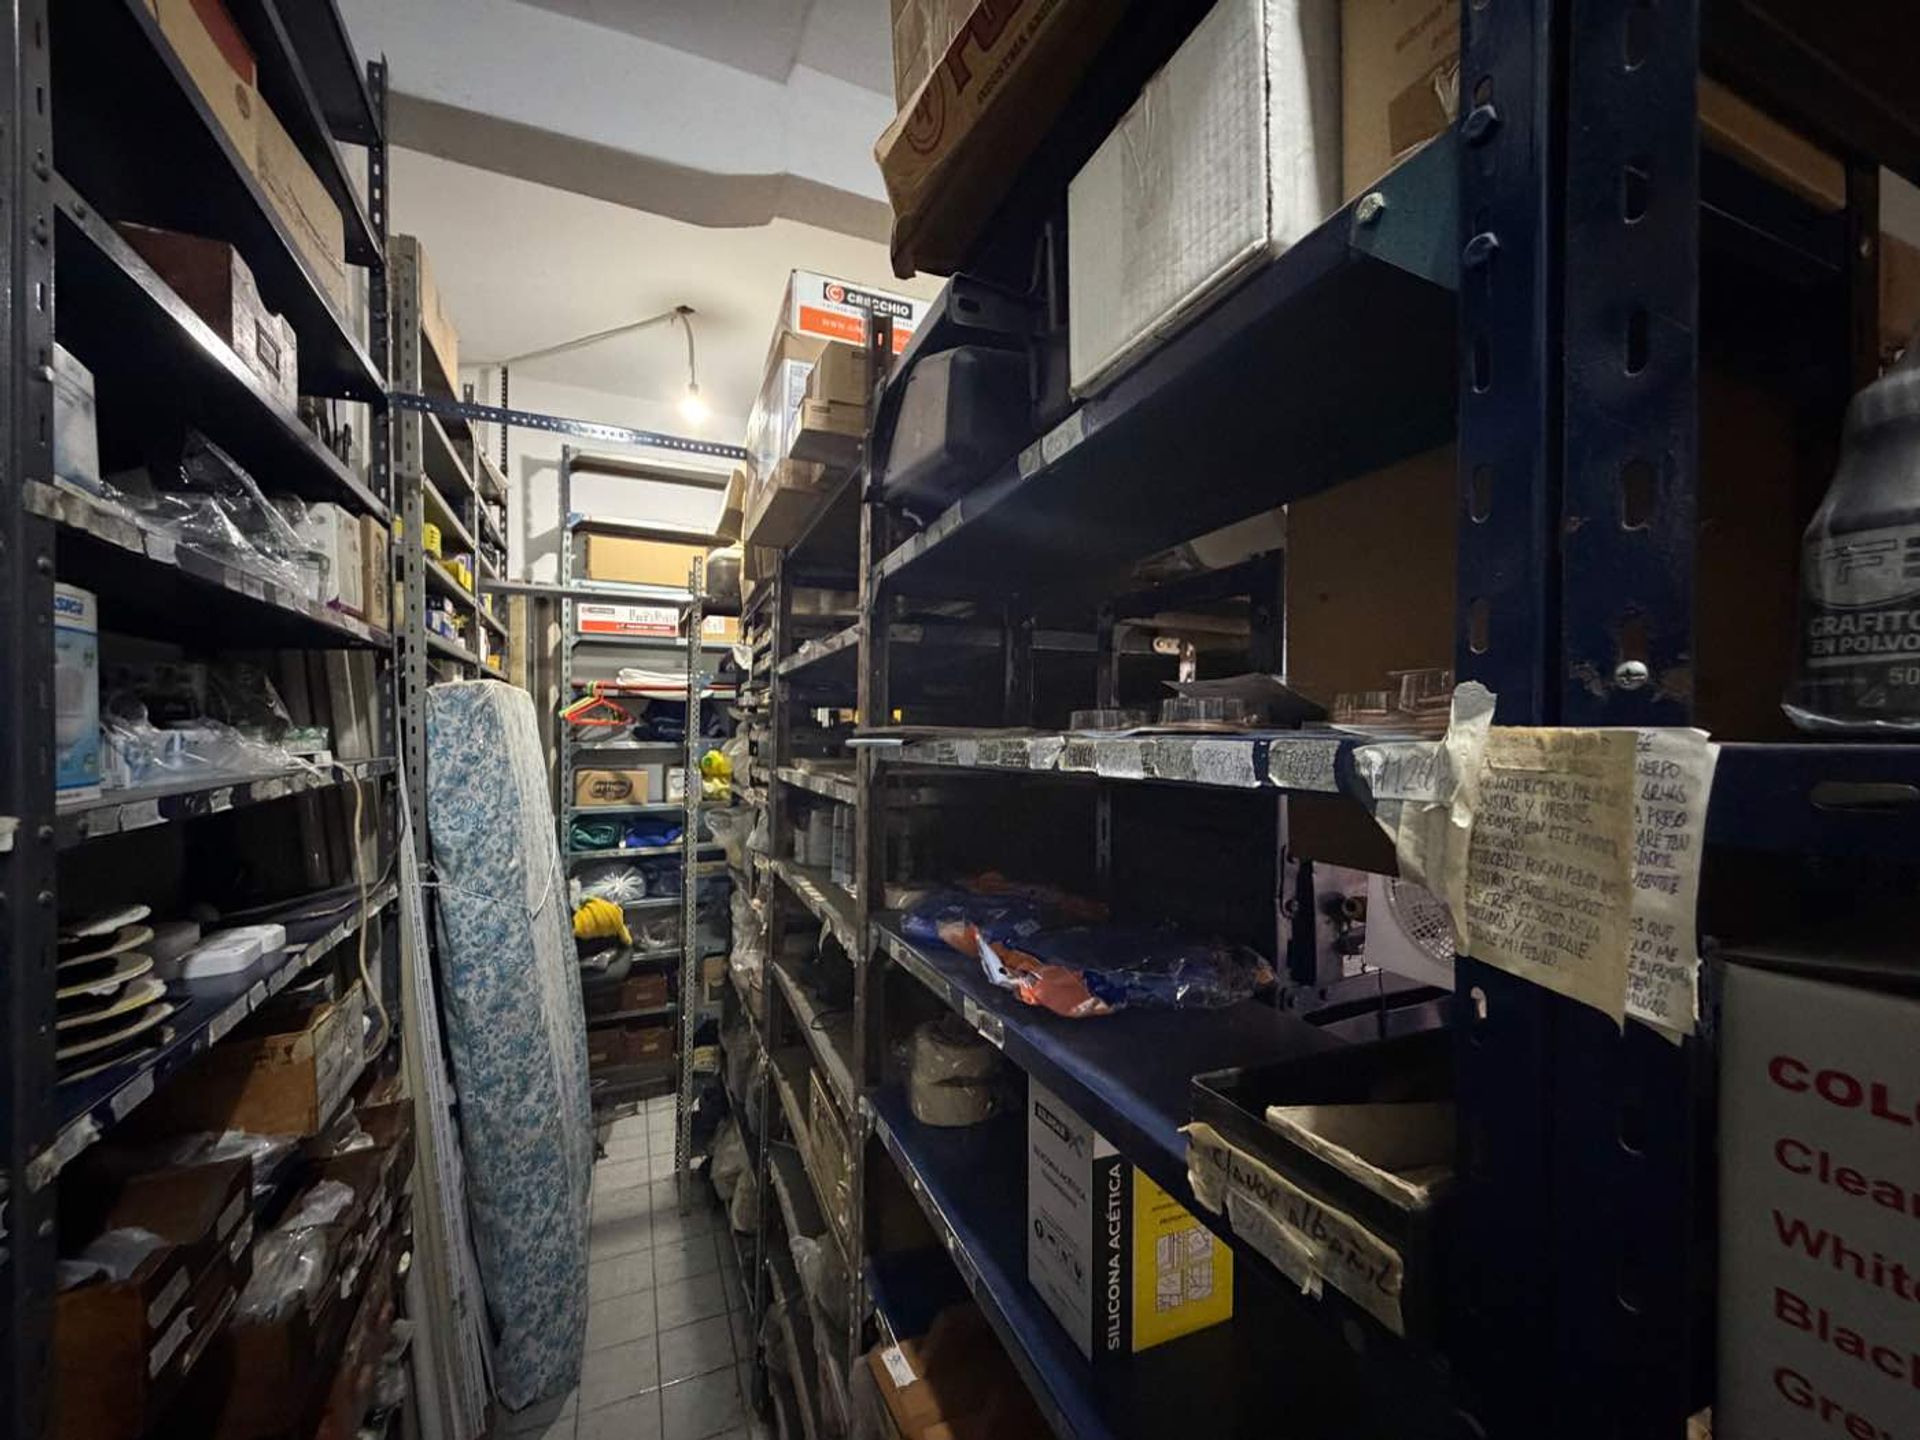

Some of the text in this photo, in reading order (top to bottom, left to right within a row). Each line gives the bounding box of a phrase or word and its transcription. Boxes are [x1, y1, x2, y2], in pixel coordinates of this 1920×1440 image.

[1809, 609, 1920, 636] GRAFITO
[1838, 633, 1920, 653] POLVO
[1768, 1055, 1920, 1126] COL
[1106, 1163, 1122, 1351] SILICONA ACÉTICA
[1772, 1208, 1920, 1303] Whit
[1774, 1366, 1893, 1440] Gre
